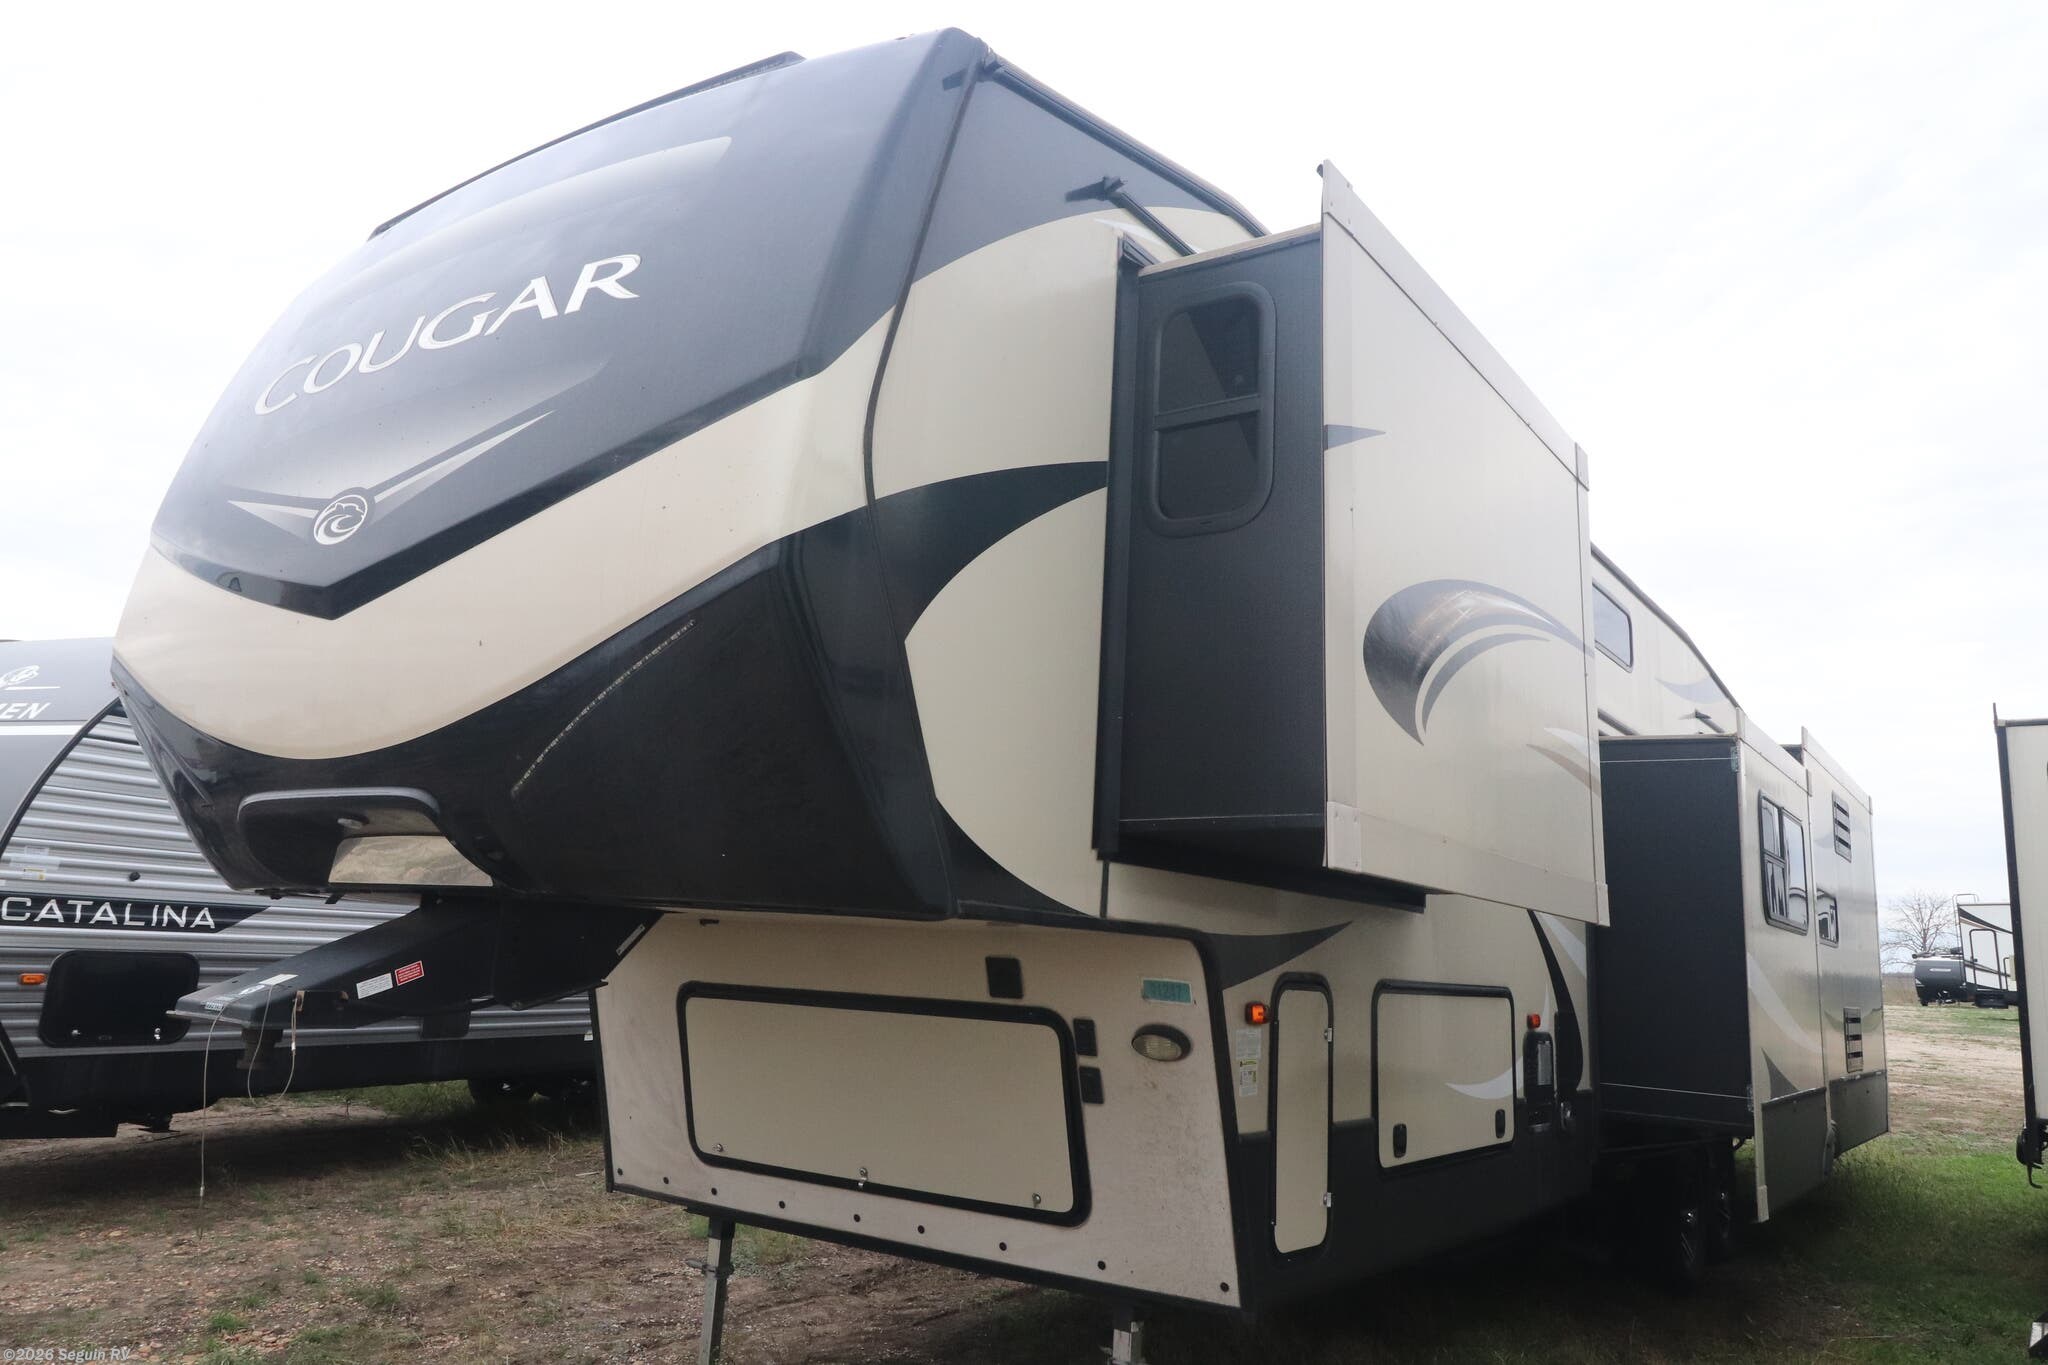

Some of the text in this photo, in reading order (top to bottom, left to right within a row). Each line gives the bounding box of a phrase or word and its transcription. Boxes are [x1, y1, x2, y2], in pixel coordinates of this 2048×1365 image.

[254, 253, 642, 417] COUGAR
[0, 702, 51, 719] EN
[1, 896, 216, 929] CATALINA
